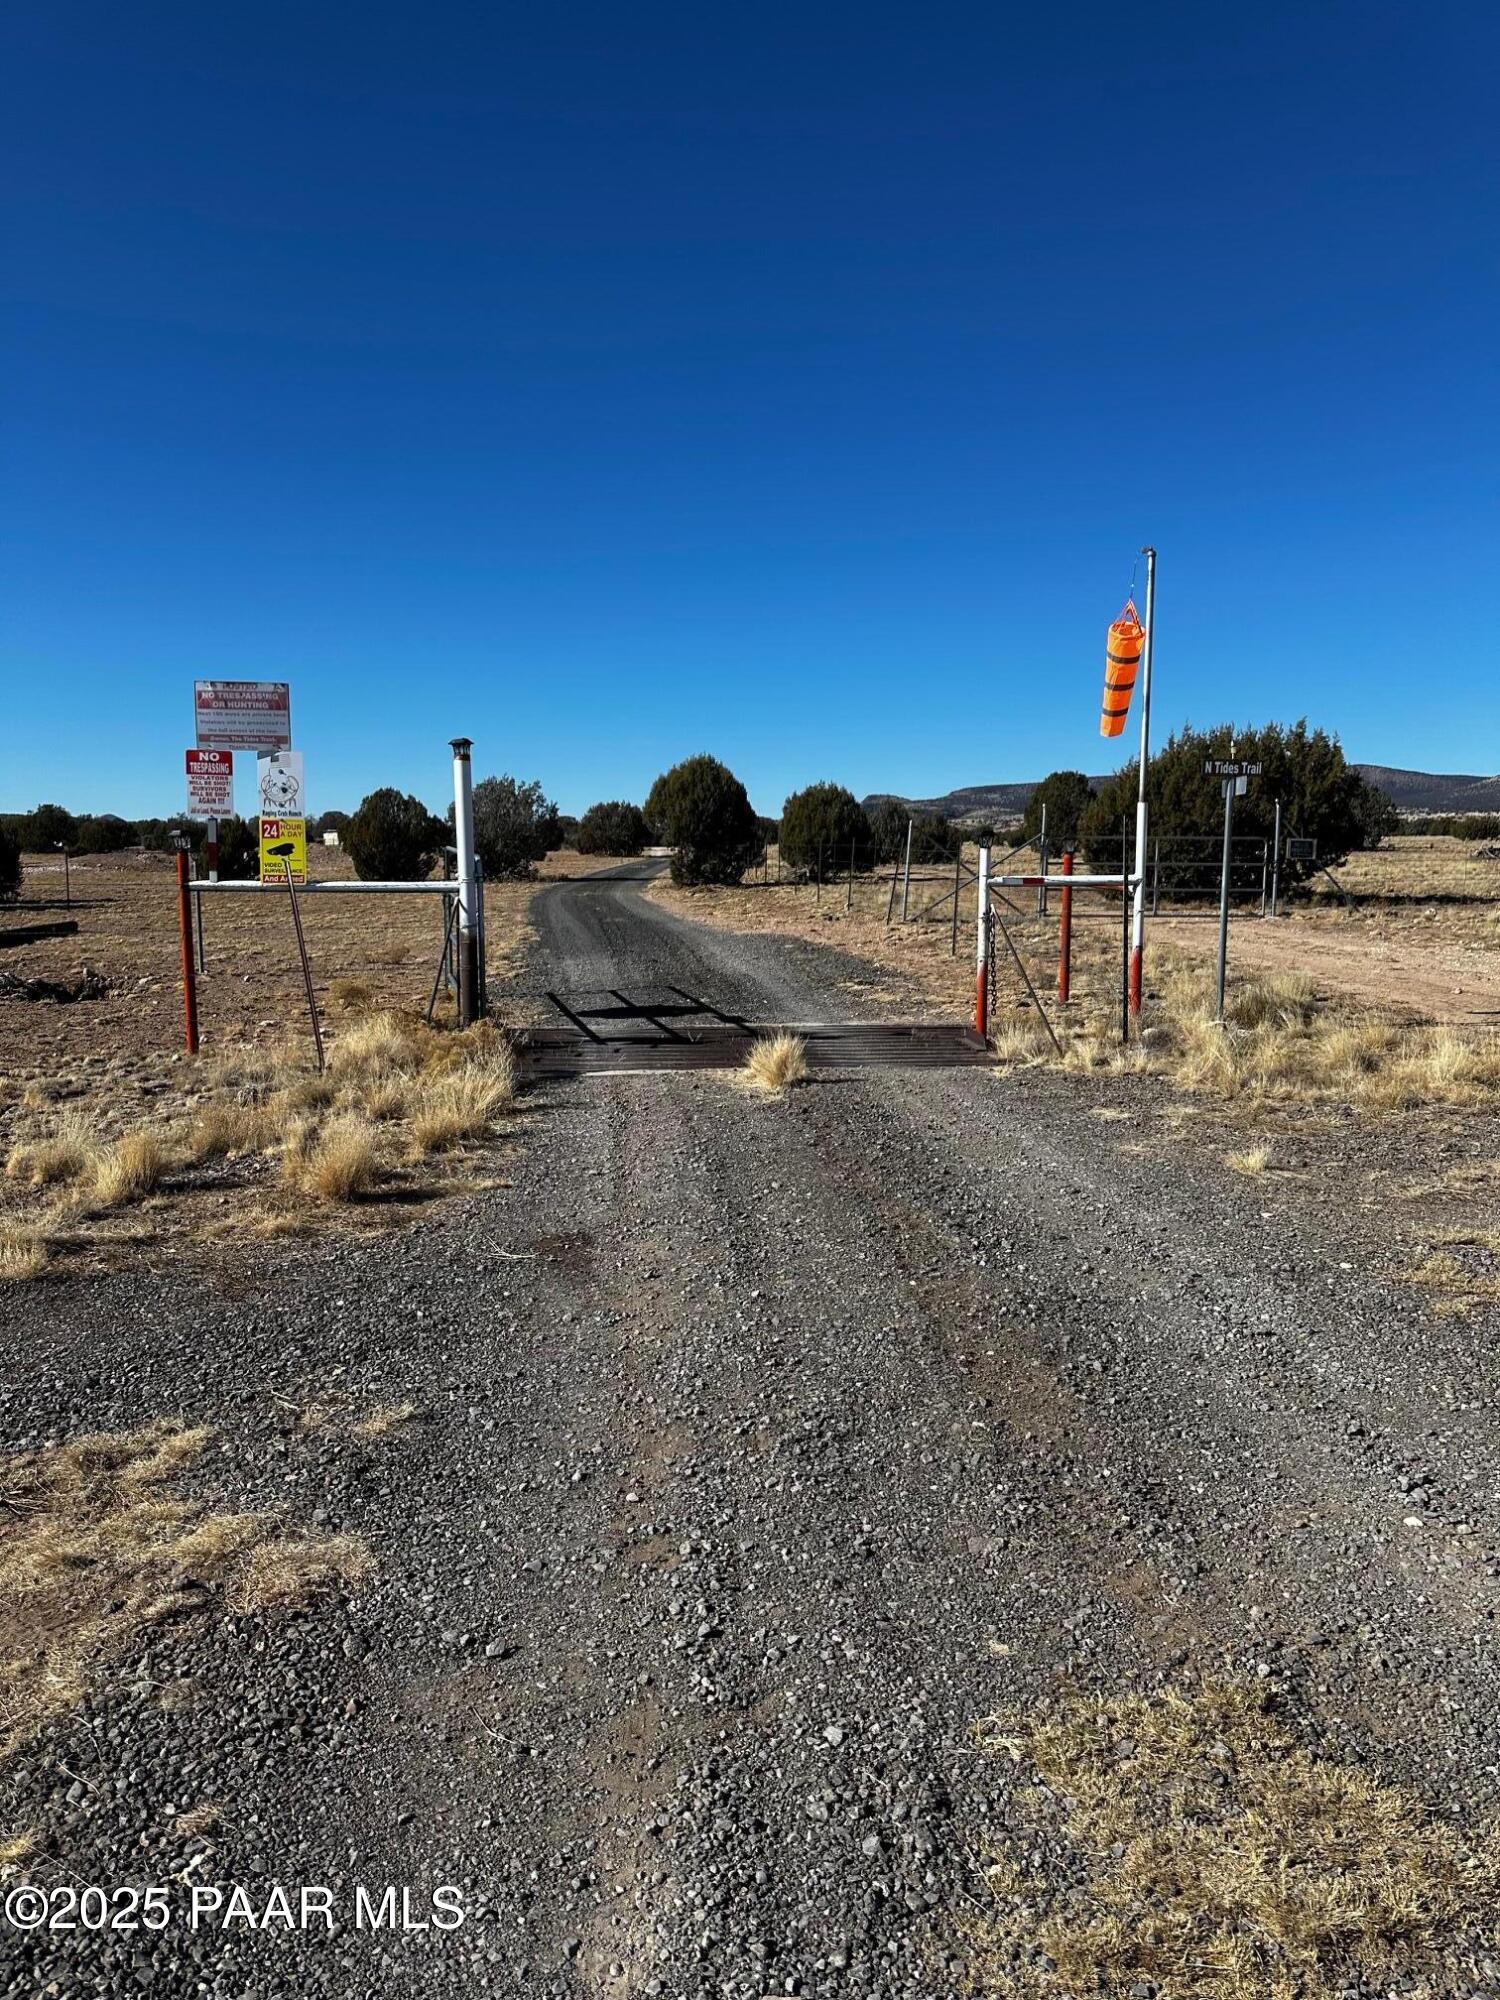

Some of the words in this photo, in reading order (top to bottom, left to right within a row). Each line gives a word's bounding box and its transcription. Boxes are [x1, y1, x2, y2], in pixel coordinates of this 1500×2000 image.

[199, 752, 220, 761] NO
[190, 762, 229, 774] TRESPASSING
[1205, 761, 1212, 774] N
[1214, 761, 1239, 774] Tides
[1242, 762, 1262, 774] Trail
[264, 824, 278, 837] 24
